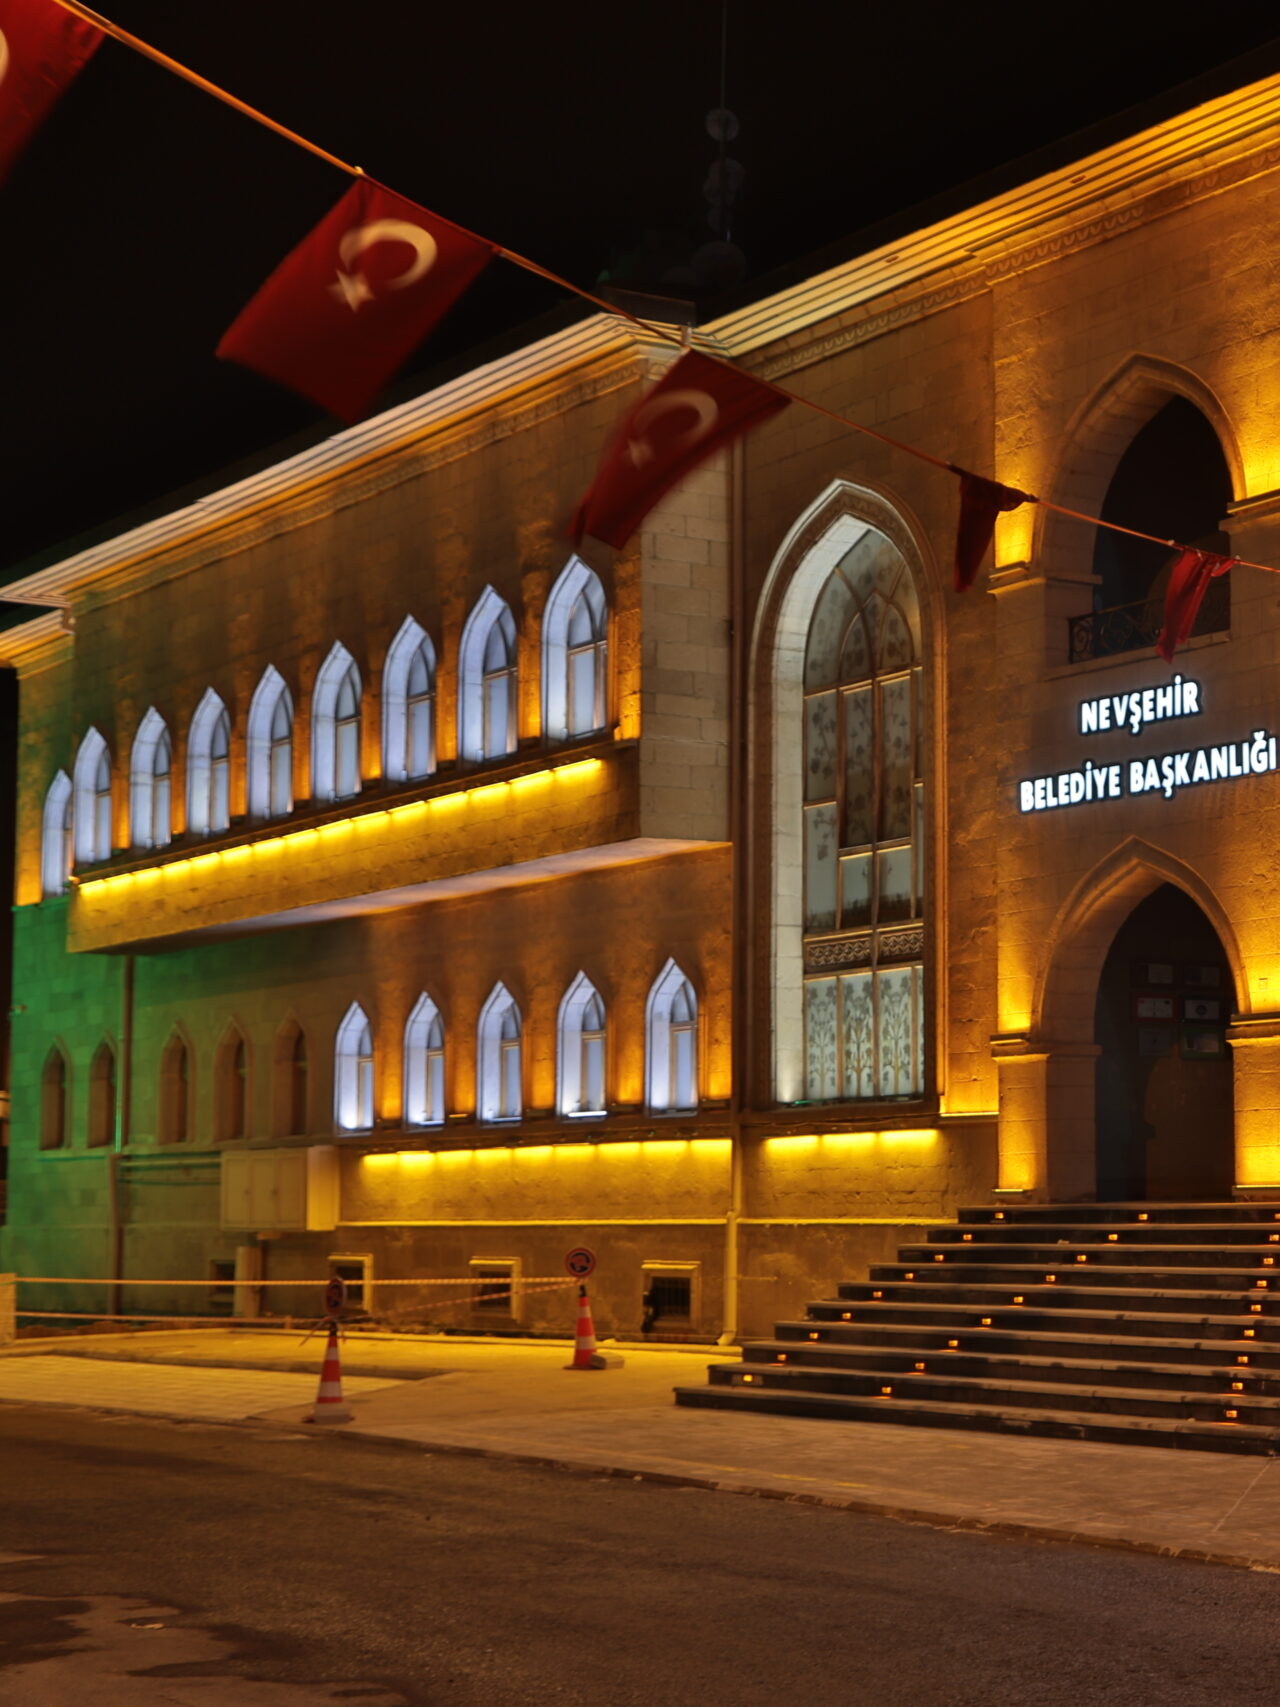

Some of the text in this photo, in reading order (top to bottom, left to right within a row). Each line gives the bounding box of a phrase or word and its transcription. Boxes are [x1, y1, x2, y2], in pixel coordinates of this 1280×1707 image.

[1081, 674, 1200, 735] NEVŞEHİR
[1019, 731, 1277, 812] BELEDİYE BAŞKANLIĞI
